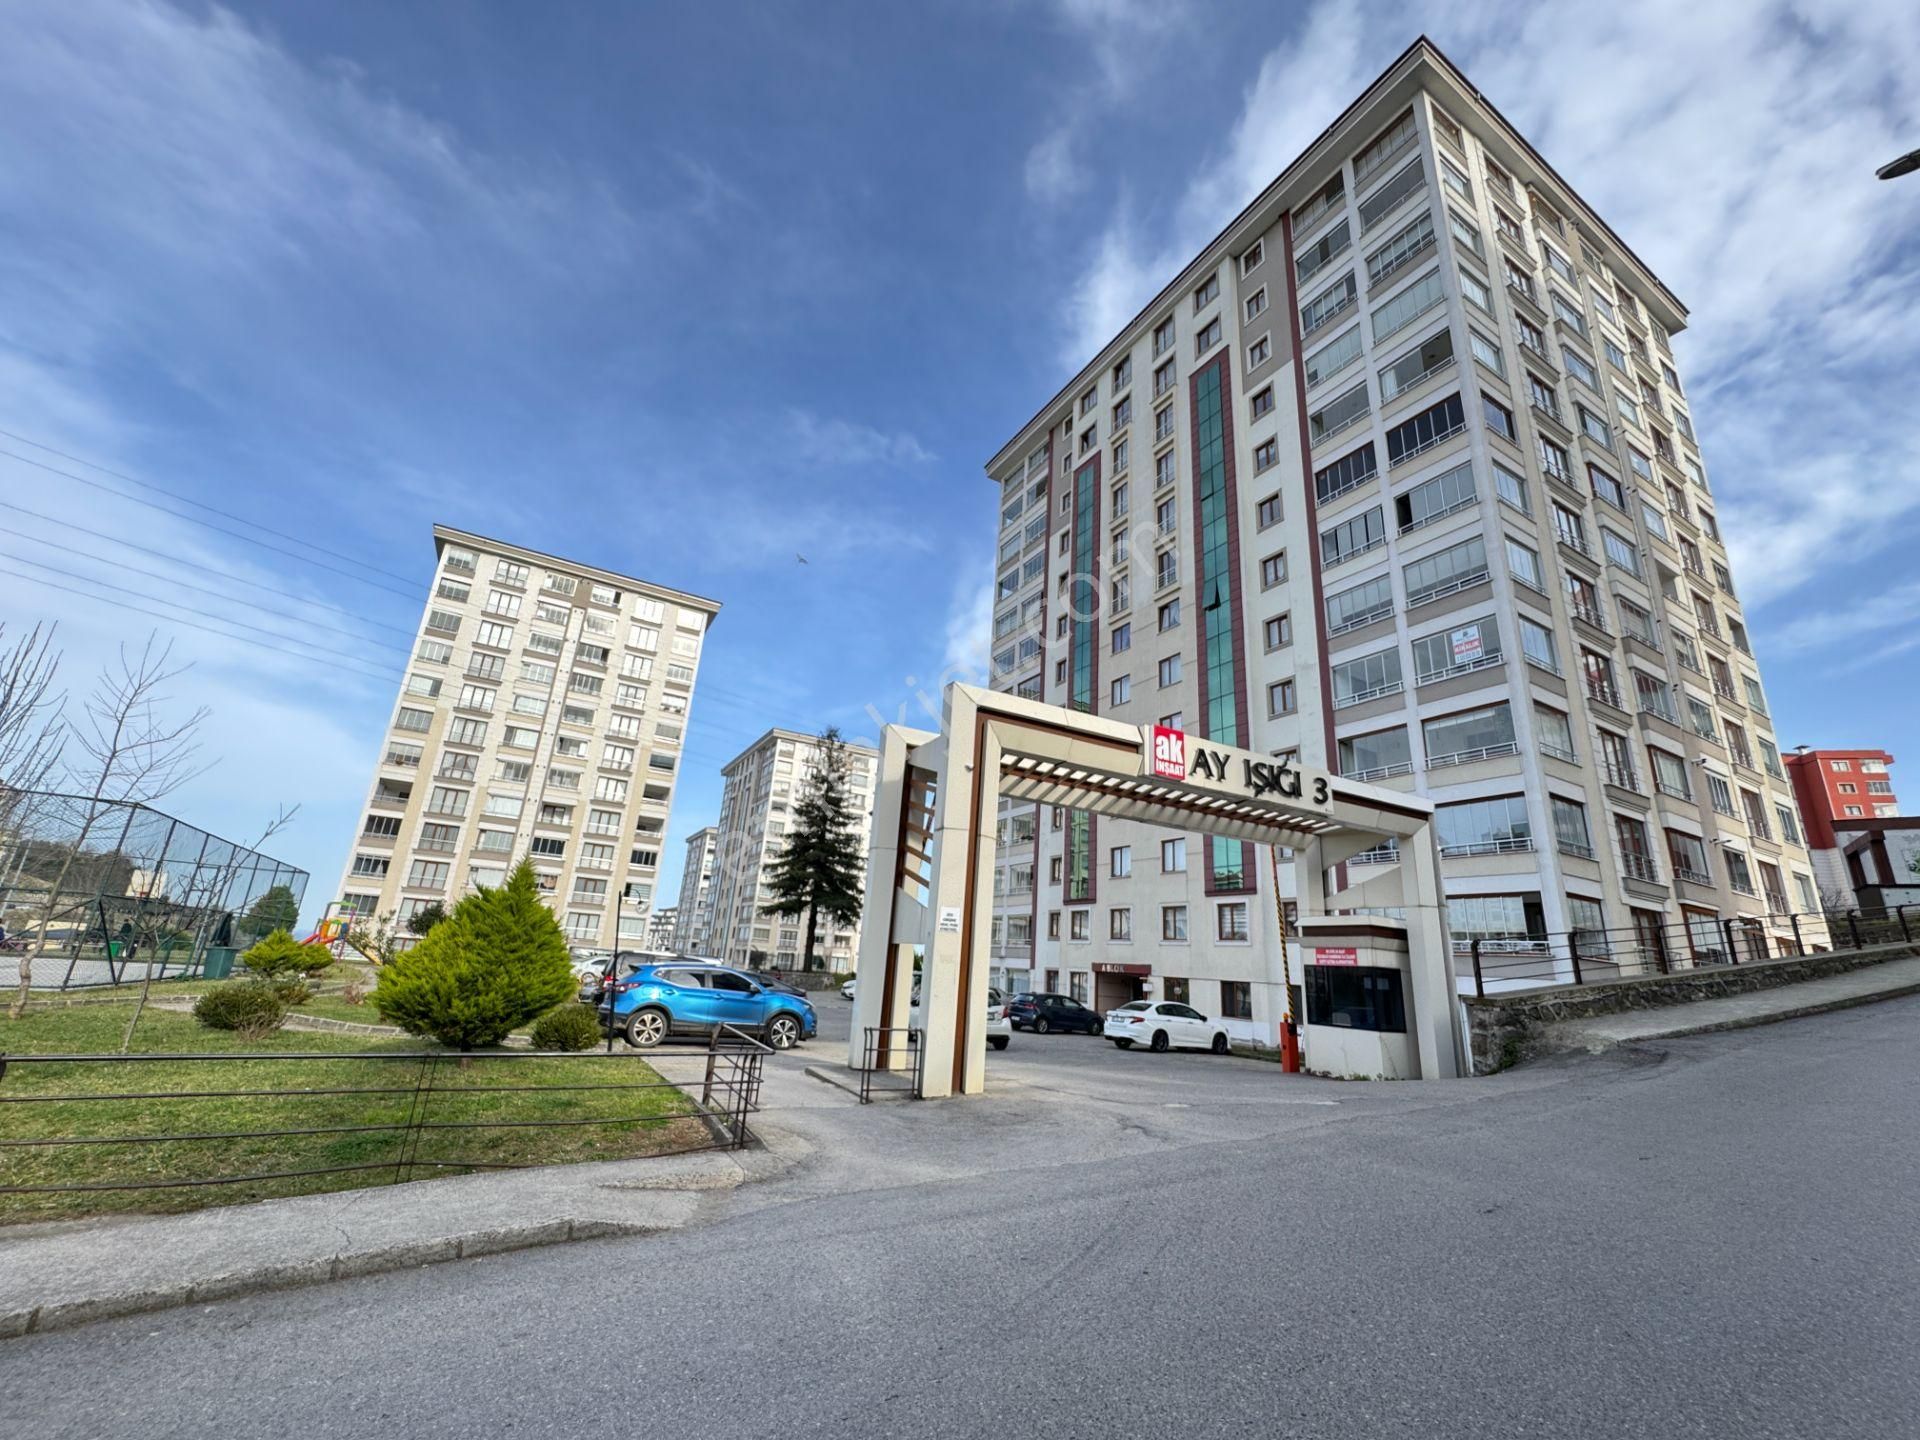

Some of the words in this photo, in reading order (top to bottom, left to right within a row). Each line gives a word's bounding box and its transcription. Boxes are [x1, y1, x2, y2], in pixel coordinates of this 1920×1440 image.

[1156, 733, 1183, 764] ak
[1189, 748, 1230, 782] AY
[1313, 777, 1329, 805] 3
